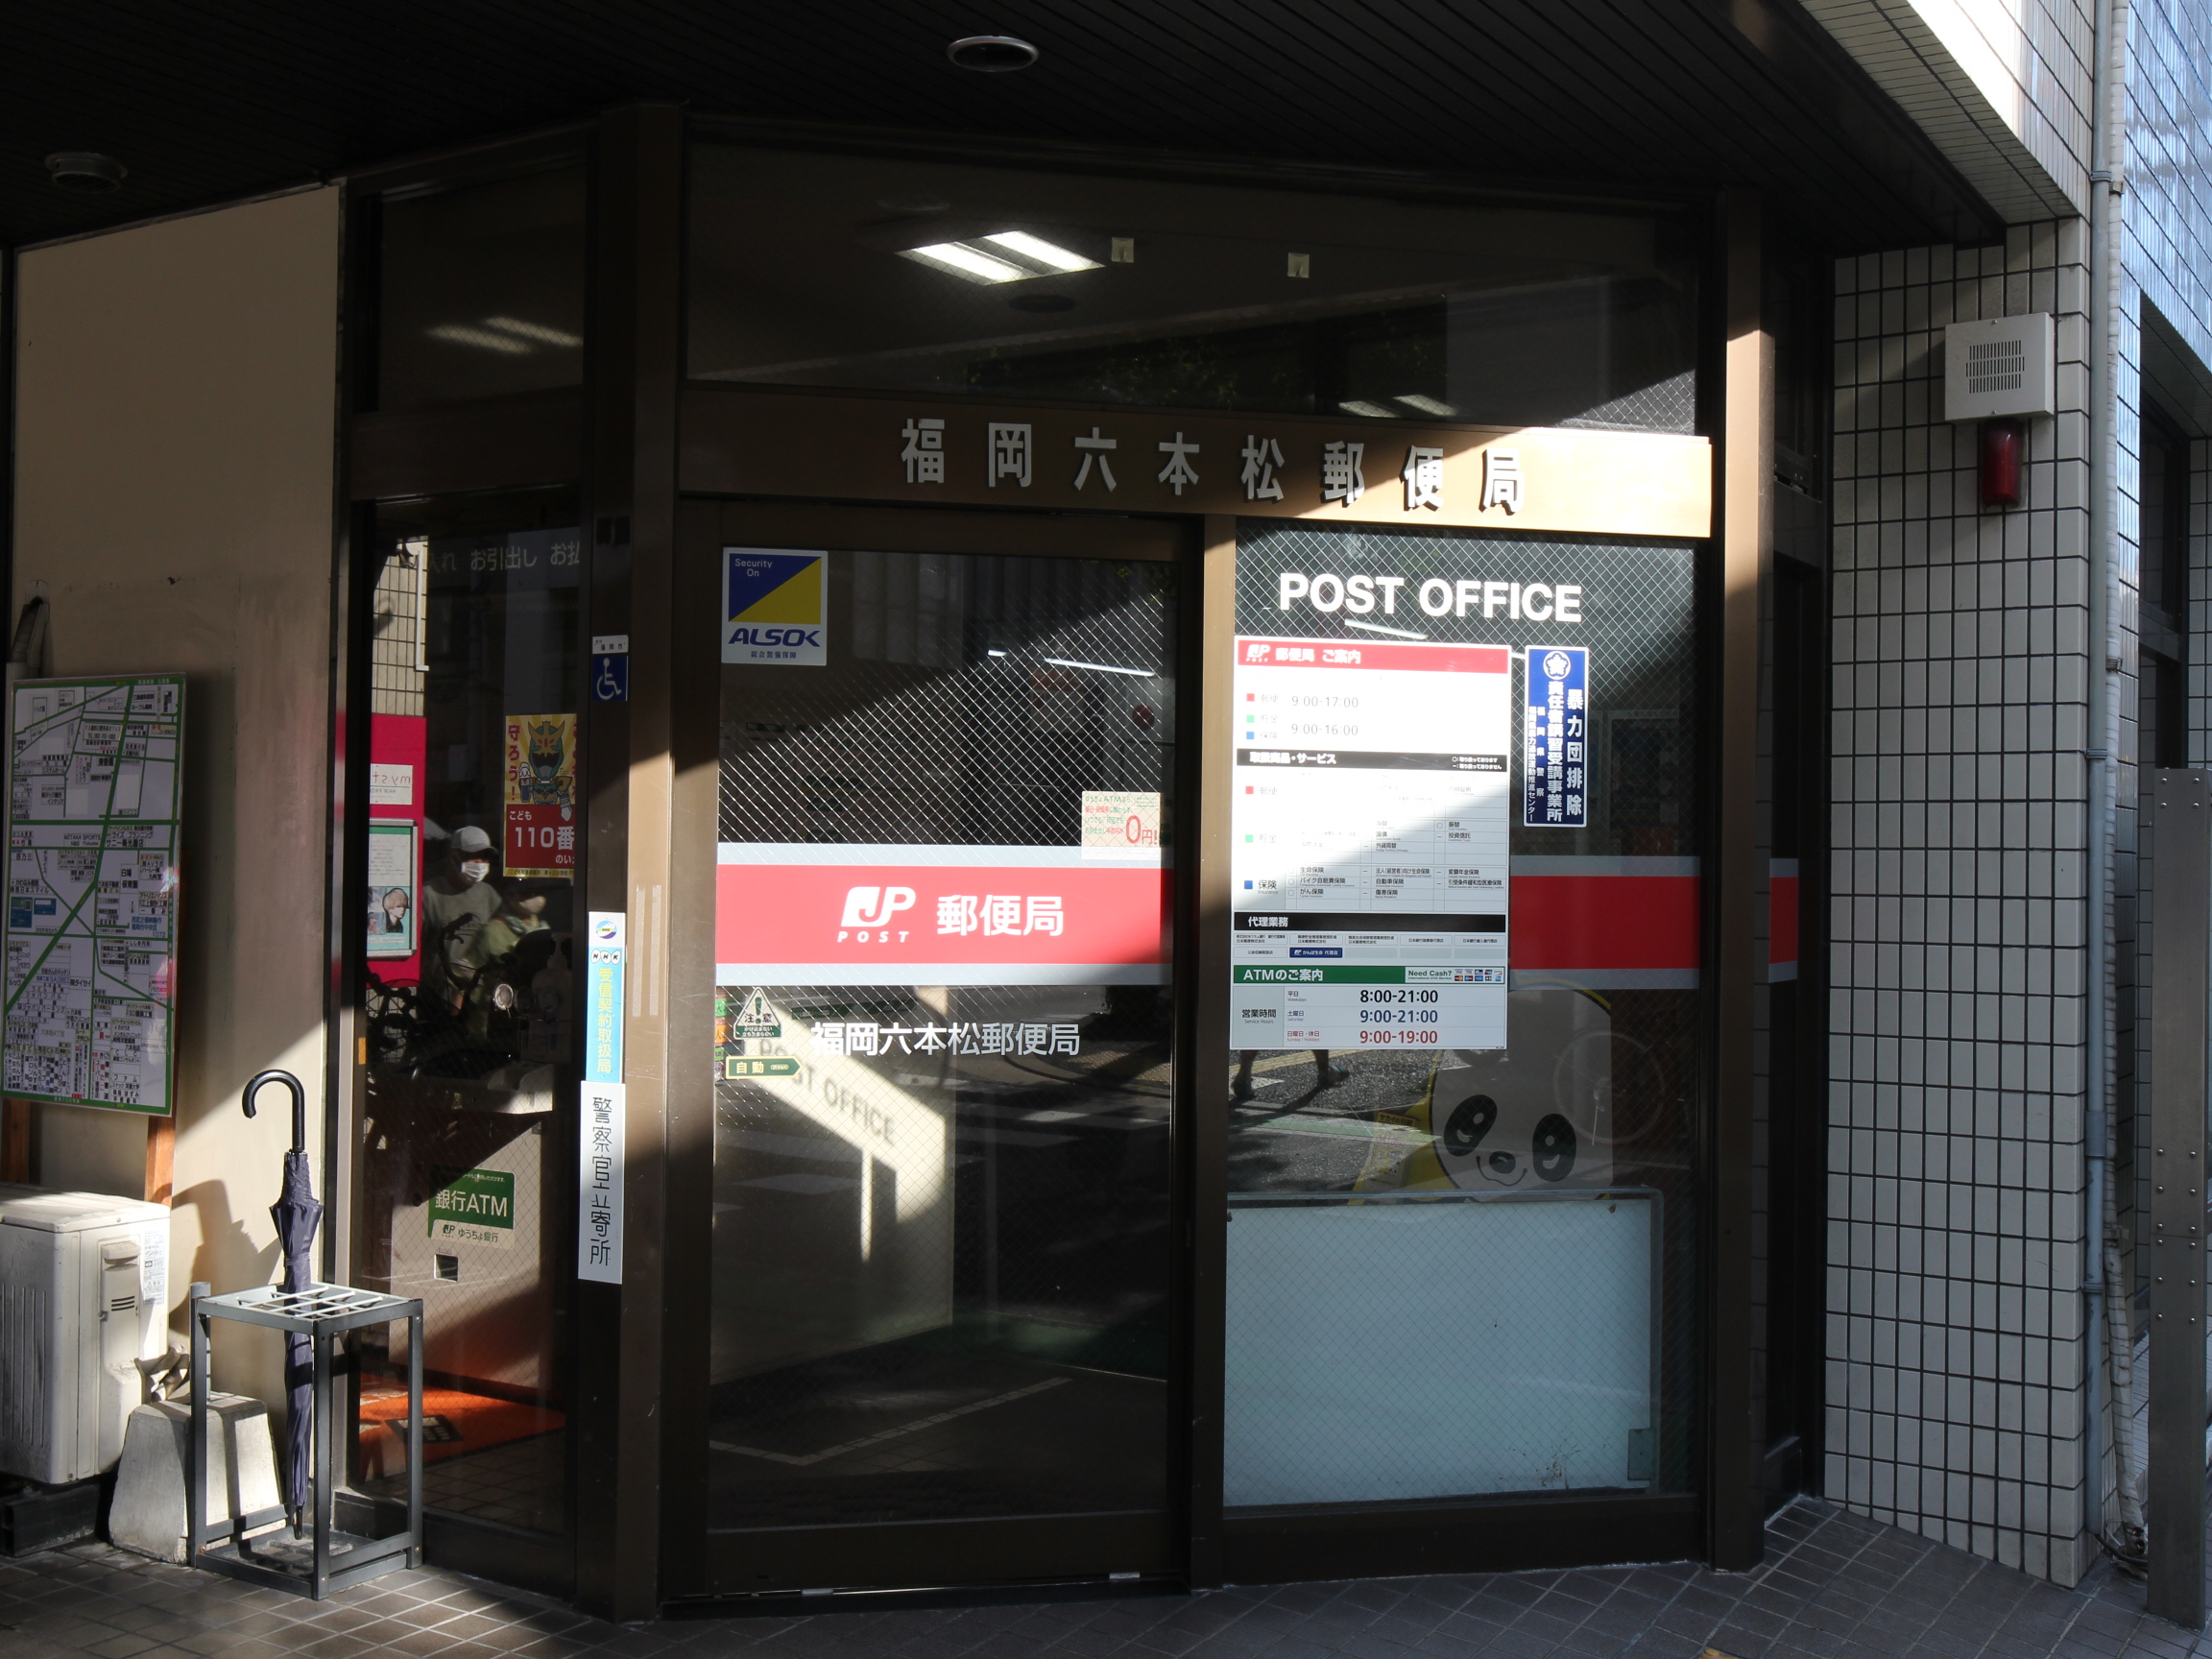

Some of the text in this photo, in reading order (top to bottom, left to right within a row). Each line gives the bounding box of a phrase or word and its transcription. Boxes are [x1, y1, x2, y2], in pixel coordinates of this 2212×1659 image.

[901, 419, 1525, 515] 福岡六本松郵便局
[470, 546, 538, 570] お引出し
[734, 558, 773, 569] Security
[746, 568, 759, 577] On
[1280, 573, 1582, 622] POST OFFICE
[728, 627, 821, 647] ALSOK
[1276, 648, 1314, 661] 郵便局
[1323, 649, 1360, 663] ご案内
[1291, 695, 1358, 709] 9:00-17:00
[1291, 723, 1358, 736] 9:00-16:00
[1249, 751, 1337, 765] 取扱商品・サービス
[1547, 681, 1564, 823] 責任者講習受講事業所
[1567, 688, 1583, 816] 暴力団排除
[509, 810, 532, 821] こども
[515, 826, 574, 850] 110番
[1258, 879, 1277, 890] 保険
[937, 895, 1064, 937] 郵便局
[1248, 917, 1288, 927] 代理業務
[837, 930, 909, 943] POST
[1242, 969, 1324, 982] ATMのご案内
[1360, 990, 1438, 1003] 8:00-21:00
[596, 967, 613, 1074] 受信契約取扱局
[1242, 1009, 1277, 1018] 営業時間
[1360, 1010, 1438, 1023] 9:00-21:00
[810, 1022, 1080, 1056] 福岡六本松郵便局
[1359, 1030, 1437, 1044] 9:00-19:00
[736, 1061, 764, 1074] 自動
[589, 1096, 613, 1266] 警察官立寄所
[435, 1190, 508, 1217] 銀行ATM
[458, 1229, 498, 1242] ゆうちょ銀行
